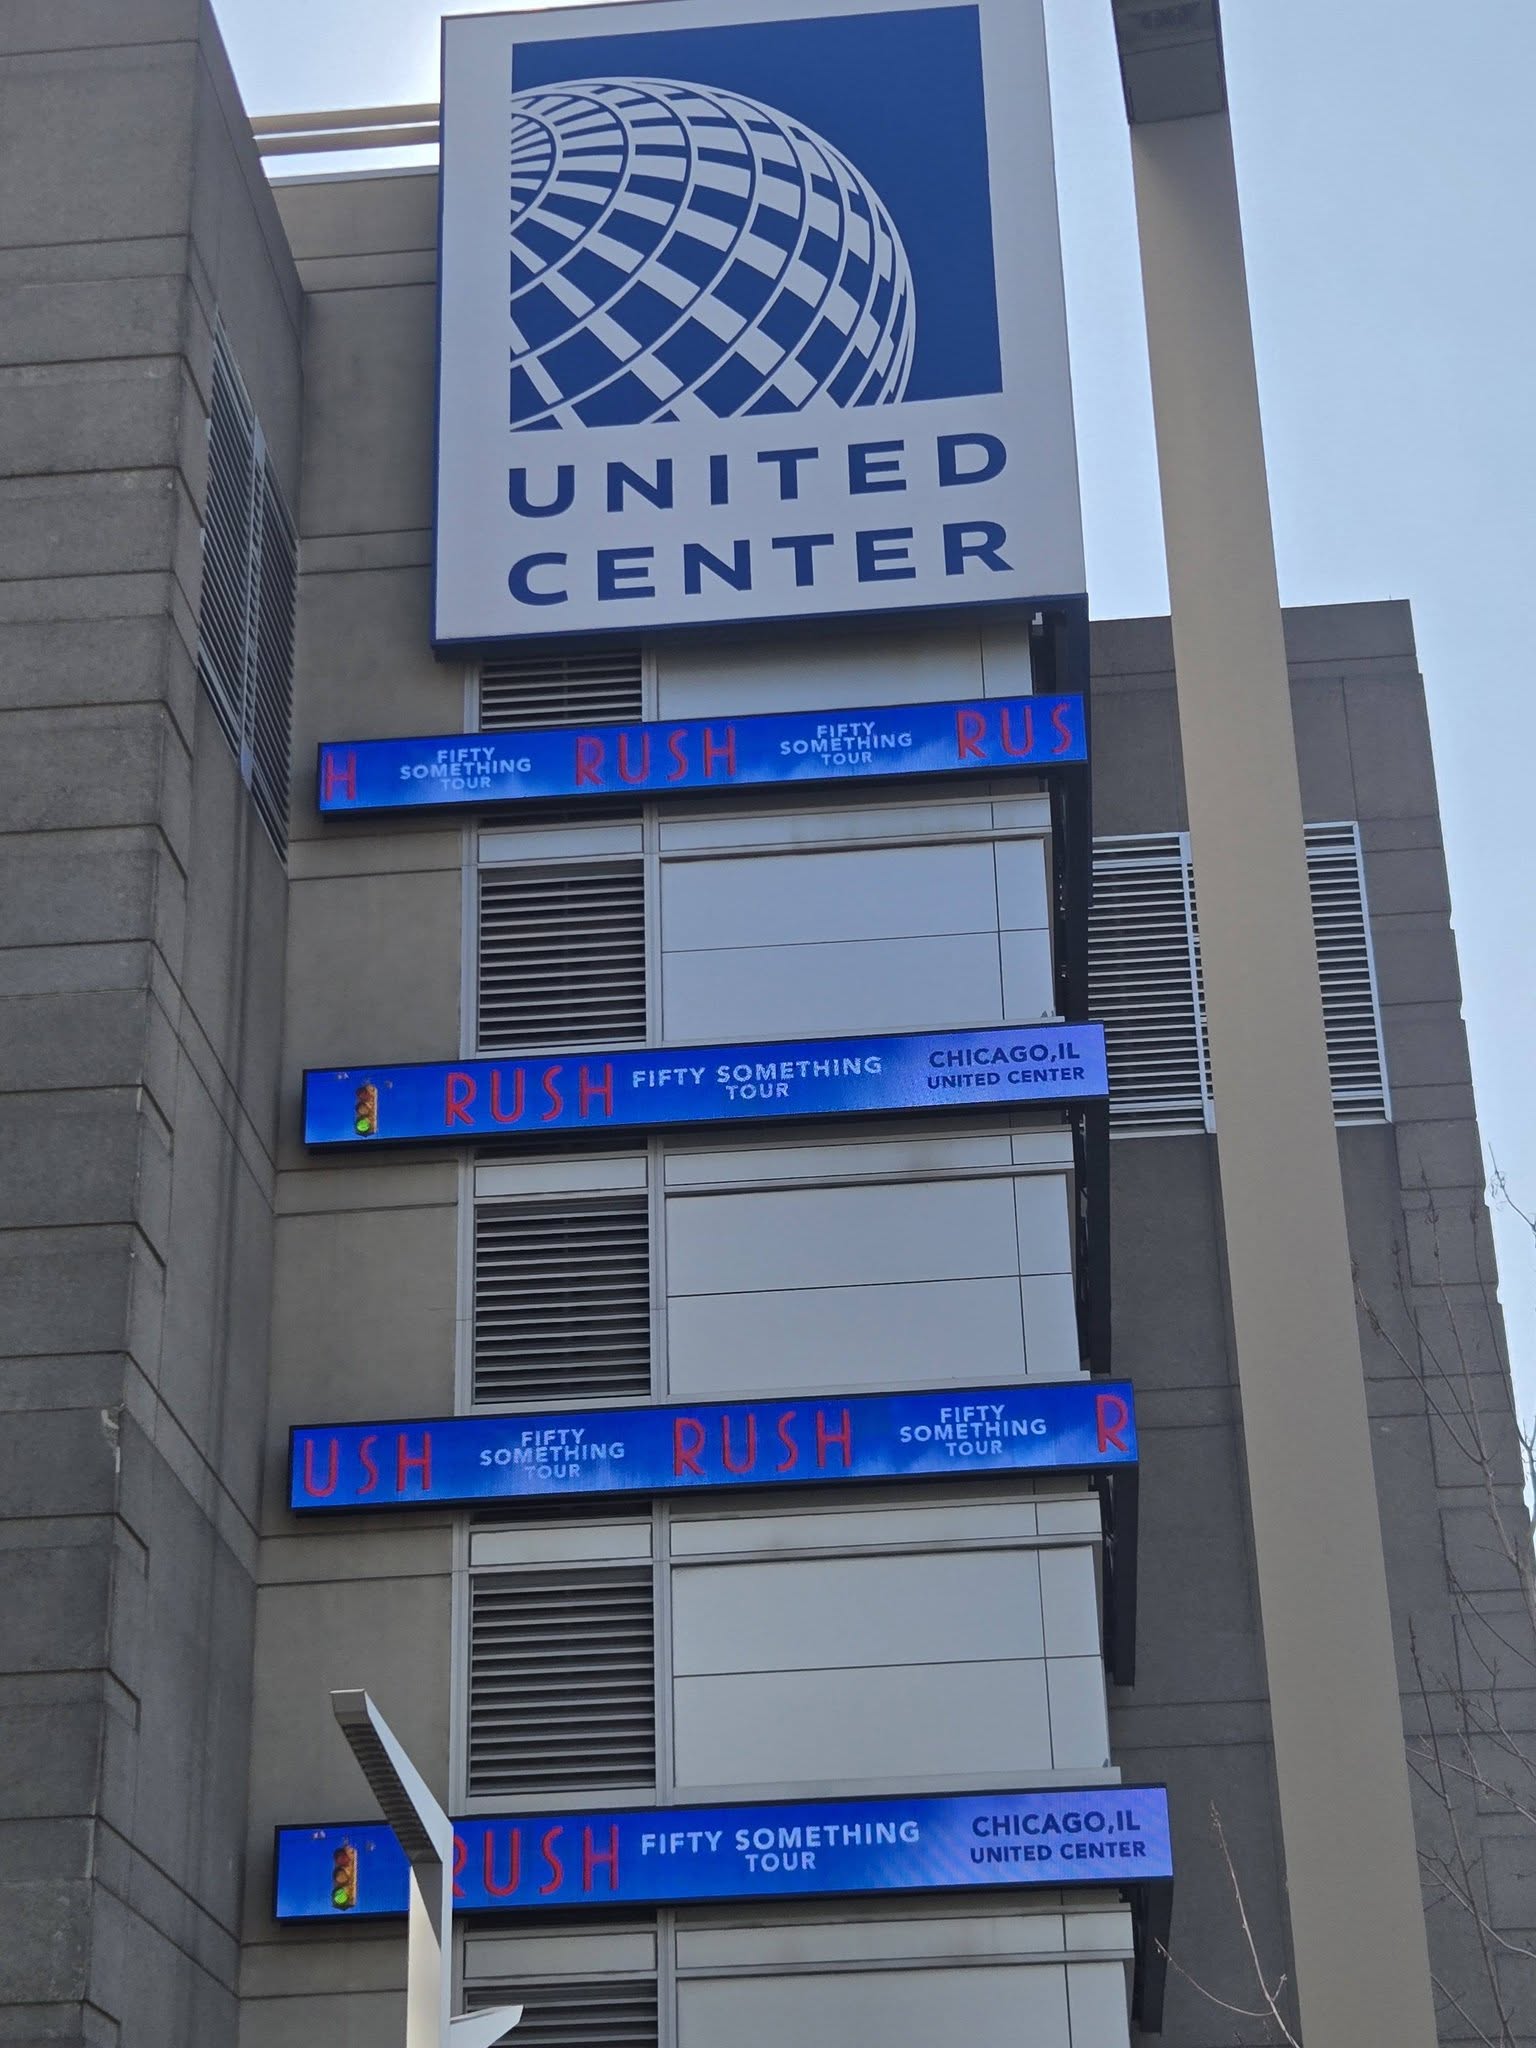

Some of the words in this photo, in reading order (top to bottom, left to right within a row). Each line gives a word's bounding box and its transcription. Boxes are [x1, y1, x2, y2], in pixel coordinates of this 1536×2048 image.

[508, 432, 1007, 518] UNITED
[508, 520, 1015, 606] CENTER
[816, 721, 876, 739] FIFTY
[955, 702, 1073, 760] RUS
[437, 746, 496, 763] FIFTY
[575, 726, 736, 786] RUSH
[779, 732, 913, 756] SOMETHING
[399, 758, 532, 780] SOMETHING
[820, 751, 873, 767] TOUR
[440, 776, 491, 791] TOUR
[928, 1042, 1081, 1069] CHICAGO,IL
[632, 1067, 706, 1089] FIFTY
[716, 1055, 883, 1085] SOMETHING
[926, 1070, 1001, 1091] UNITED
[1007, 1065, 1086, 1084] CENTER
[444, 1063, 615, 1127] RUSH
[725, 1082, 790, 1101] TOUR
[939, 1403, 1005, 1424] FIFTY
[520, 1428, 586, 1448] FIFTY
[672, 1407, 852, 1477] RUSH
[900, 1418, 1048, 1444] SOMETHING
[479, 1441, 626, 1468] SOMETHING
[945, 1440, 1003, 1458] TOUR
[303, 1431, 433, 1498] USH
[524, 1464, 582, 1481] TOUR
[971, 1808, 1142, 1838] CHICAGO,IL
[640, 1830, 724, 1856] FIFTY
[734, 1819, 921, 1852] SOMETHING
[744, 1850, 817, 1873] TOUR
[969, 1843, 1053, 1865] UNITED
[1060, 1839, 1147, 1862] CENTER
